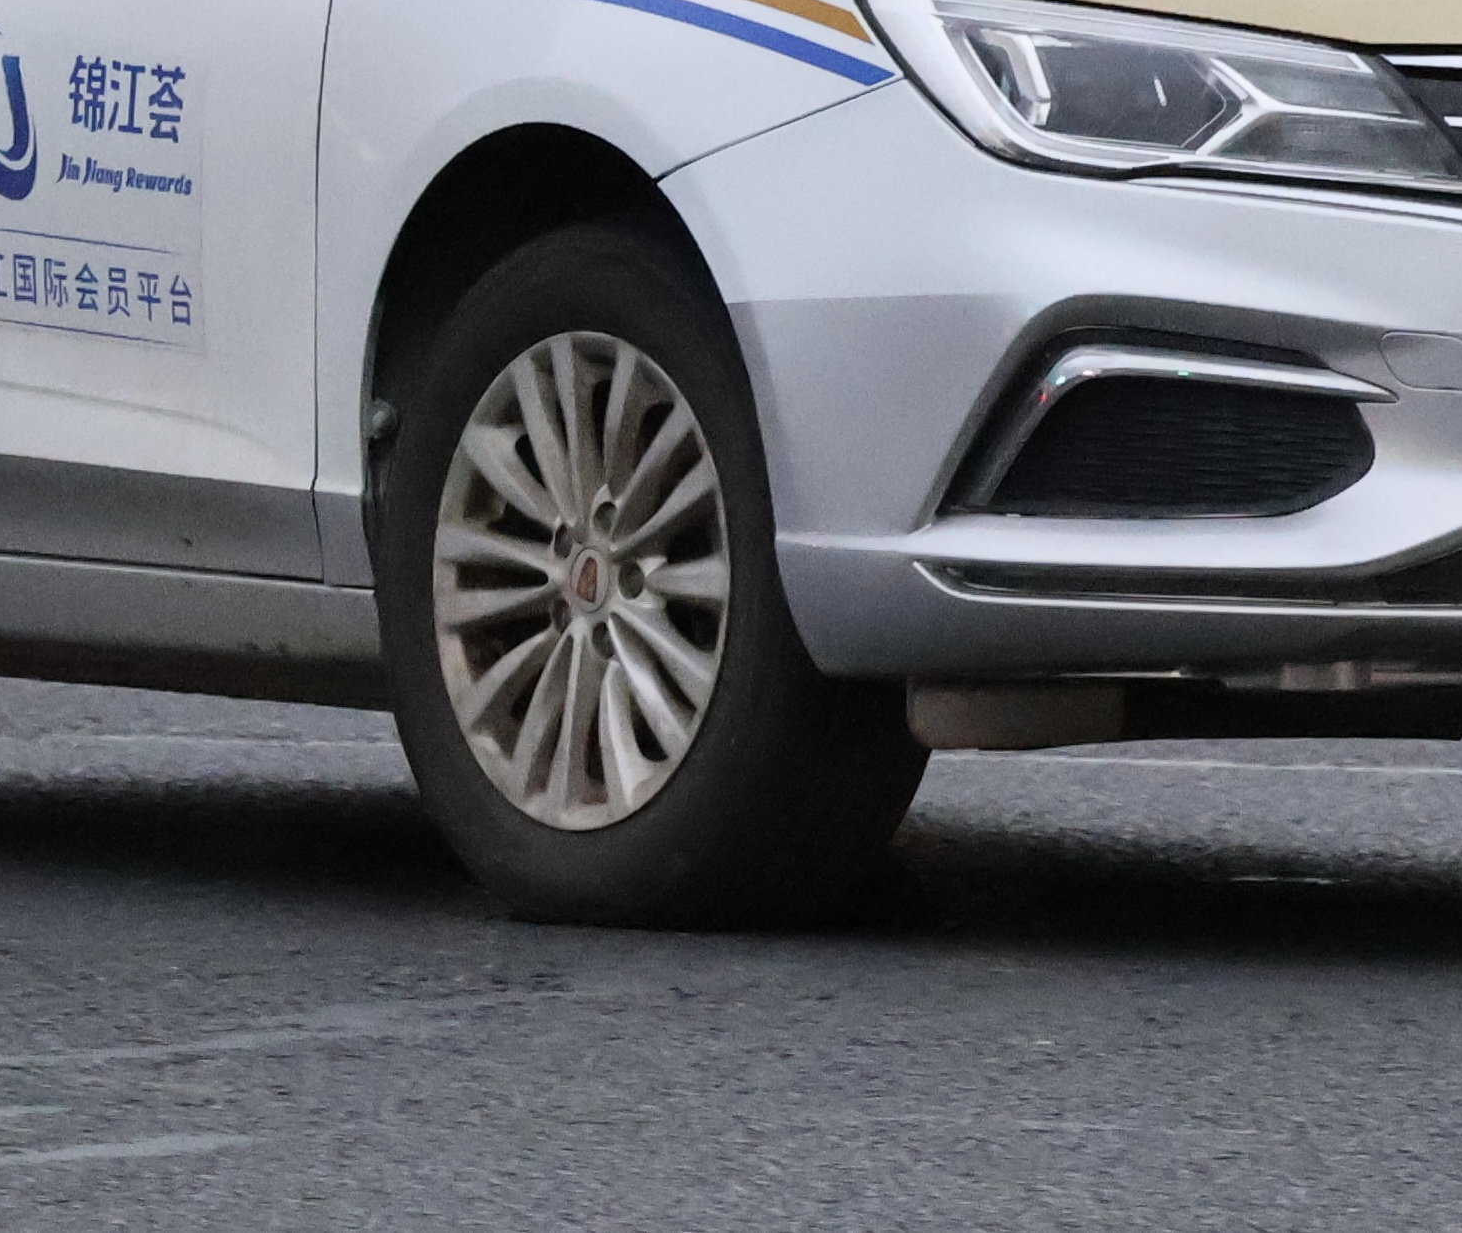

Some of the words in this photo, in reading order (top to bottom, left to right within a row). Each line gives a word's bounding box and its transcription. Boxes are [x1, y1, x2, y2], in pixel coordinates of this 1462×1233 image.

[68, 54, 186, 144] 锦江荟
[55, 153, 81, 184] Jin
[81, 156, 124, 193] Jiang
[125, 167, 193, 196] Rewards
